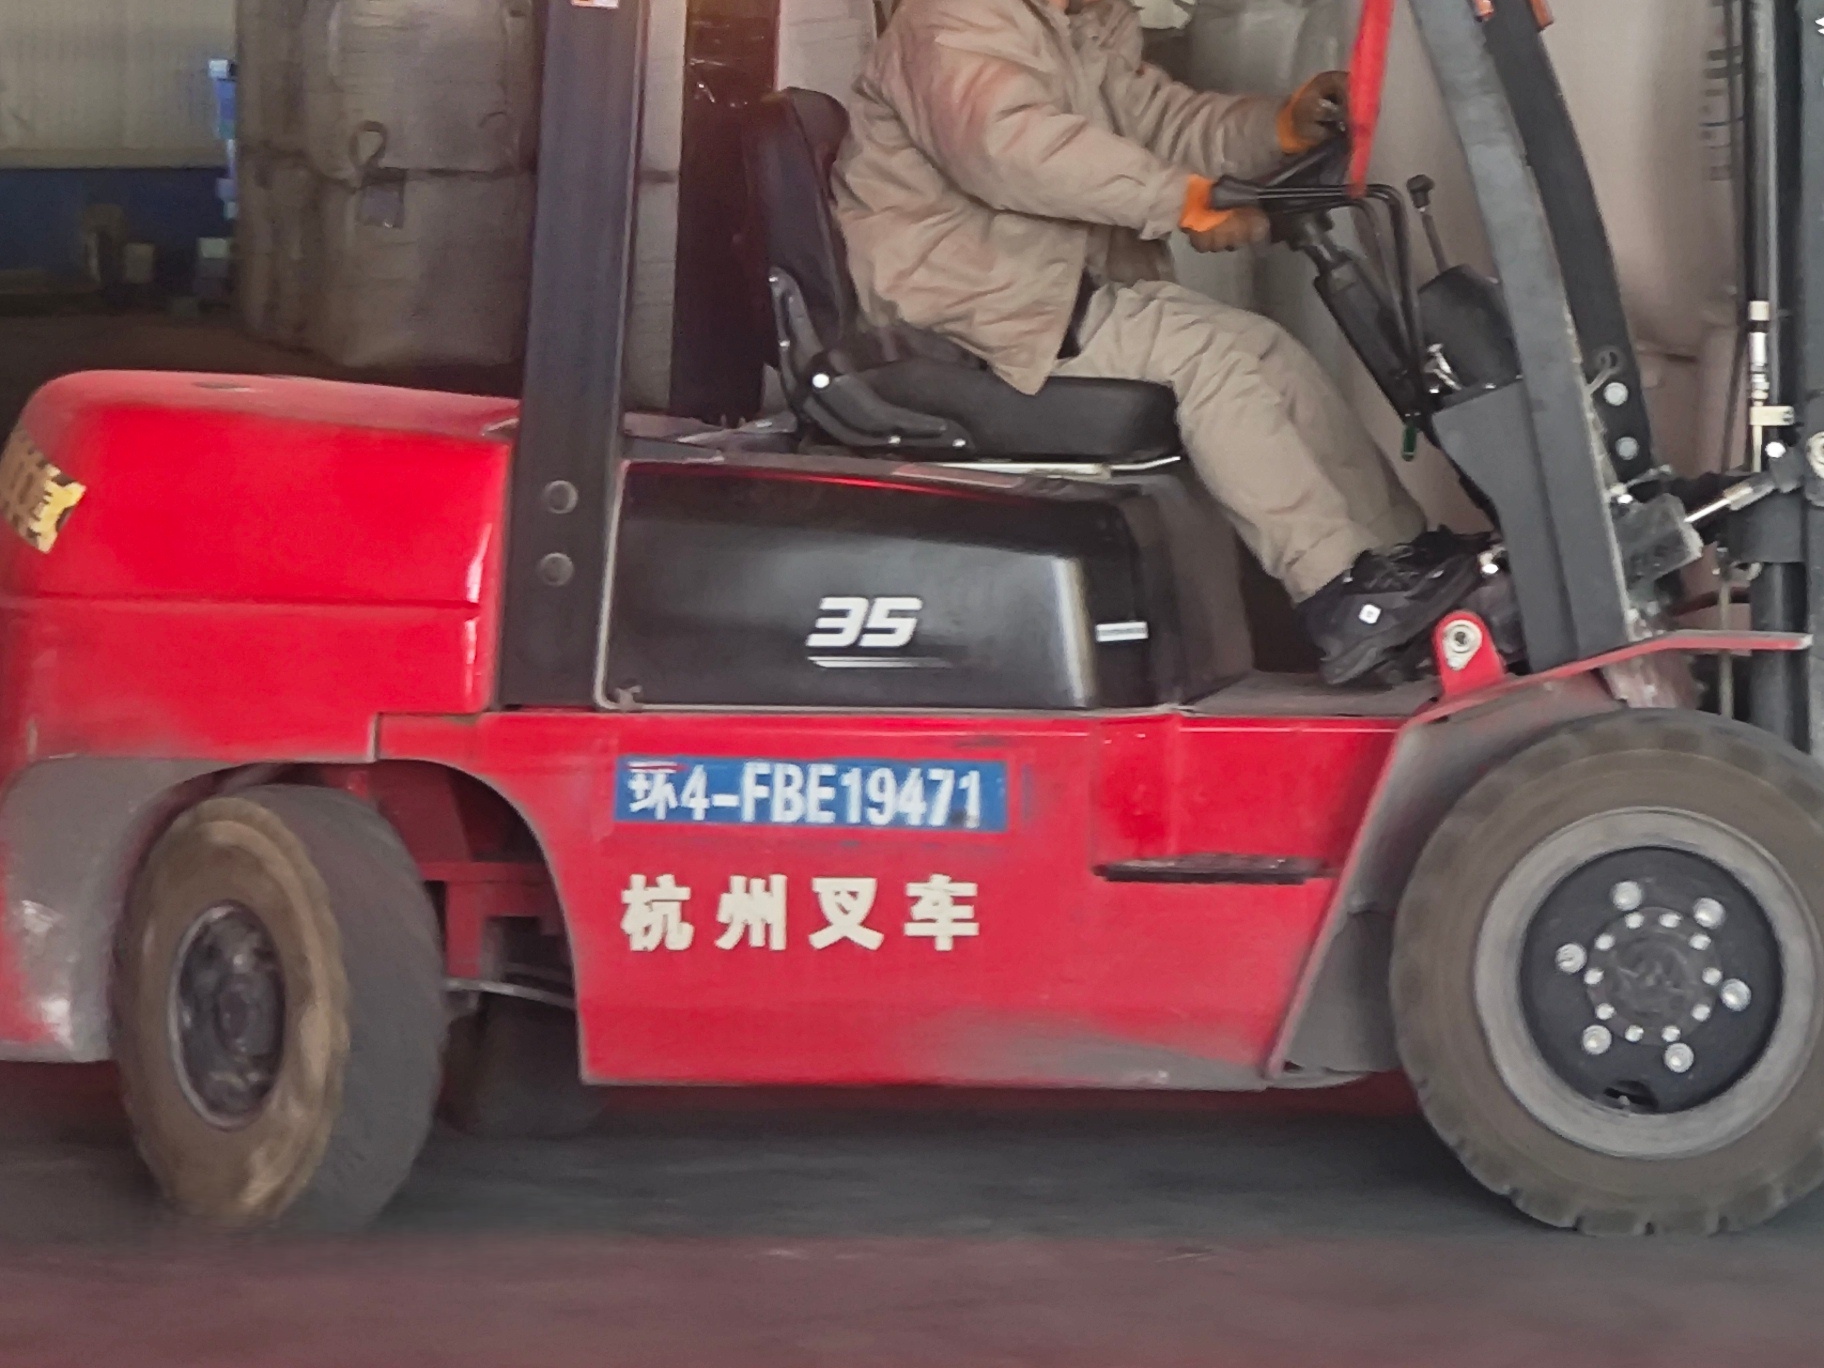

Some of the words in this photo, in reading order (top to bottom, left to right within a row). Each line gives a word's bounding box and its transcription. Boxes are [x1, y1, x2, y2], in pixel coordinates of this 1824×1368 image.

[805, 596, 923, 648] 35
[620, 872, 980, 952] 杭州叉车
